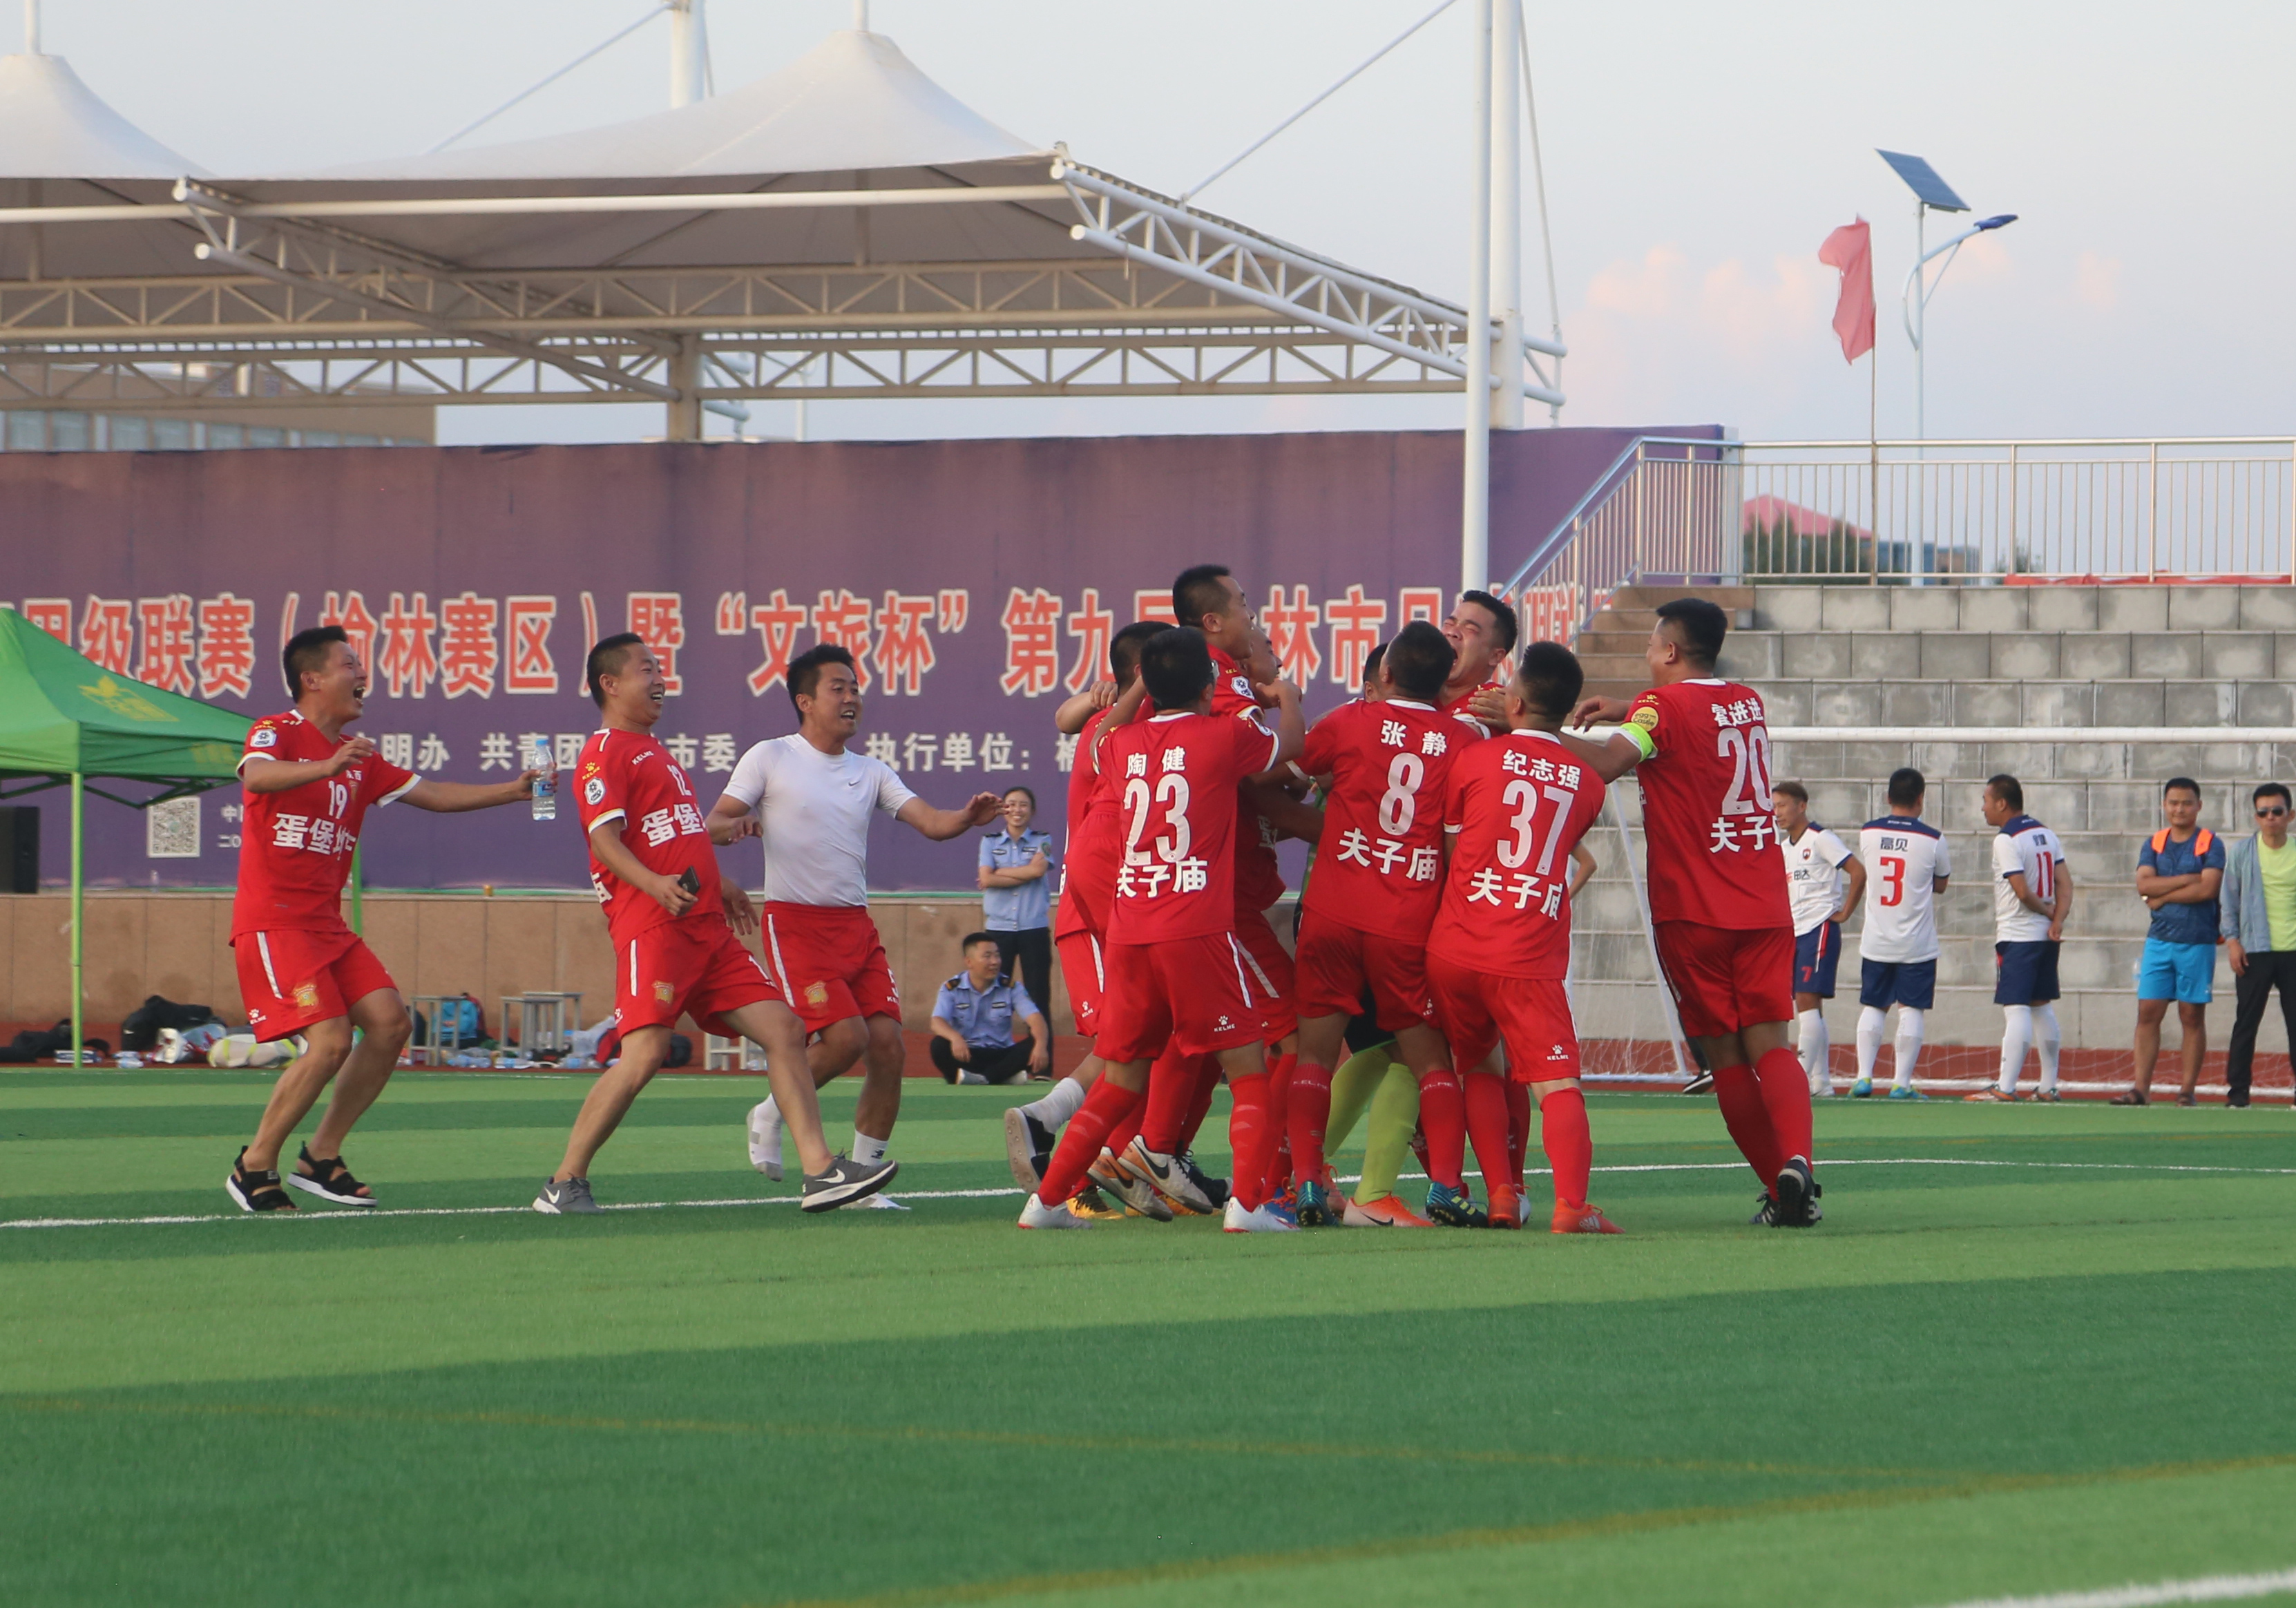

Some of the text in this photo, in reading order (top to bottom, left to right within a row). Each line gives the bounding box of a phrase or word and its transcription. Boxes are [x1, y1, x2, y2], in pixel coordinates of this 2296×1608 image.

[631, 750, 654, 765] KELME
[1502, 749, 1582, 791] 纪志强
[1717, 725, 1774, 816] 20
[328, 780, 348, 820] 19
[1379, 752, 1424, 836] 8
[1122, 773, 1190, 866] 23
[1496, 779, 1575, 876] 37
[1709, 815, 1781, 854] 夫子
[1337, 827, 1439, 882] 夫子庙
[2036, 851, 2053, 898] 11
[1880, 856, 1906, 907] 3
[1801, 966, 1813, 983] 7
[1214, 1023, 1236, 1032] KELME
